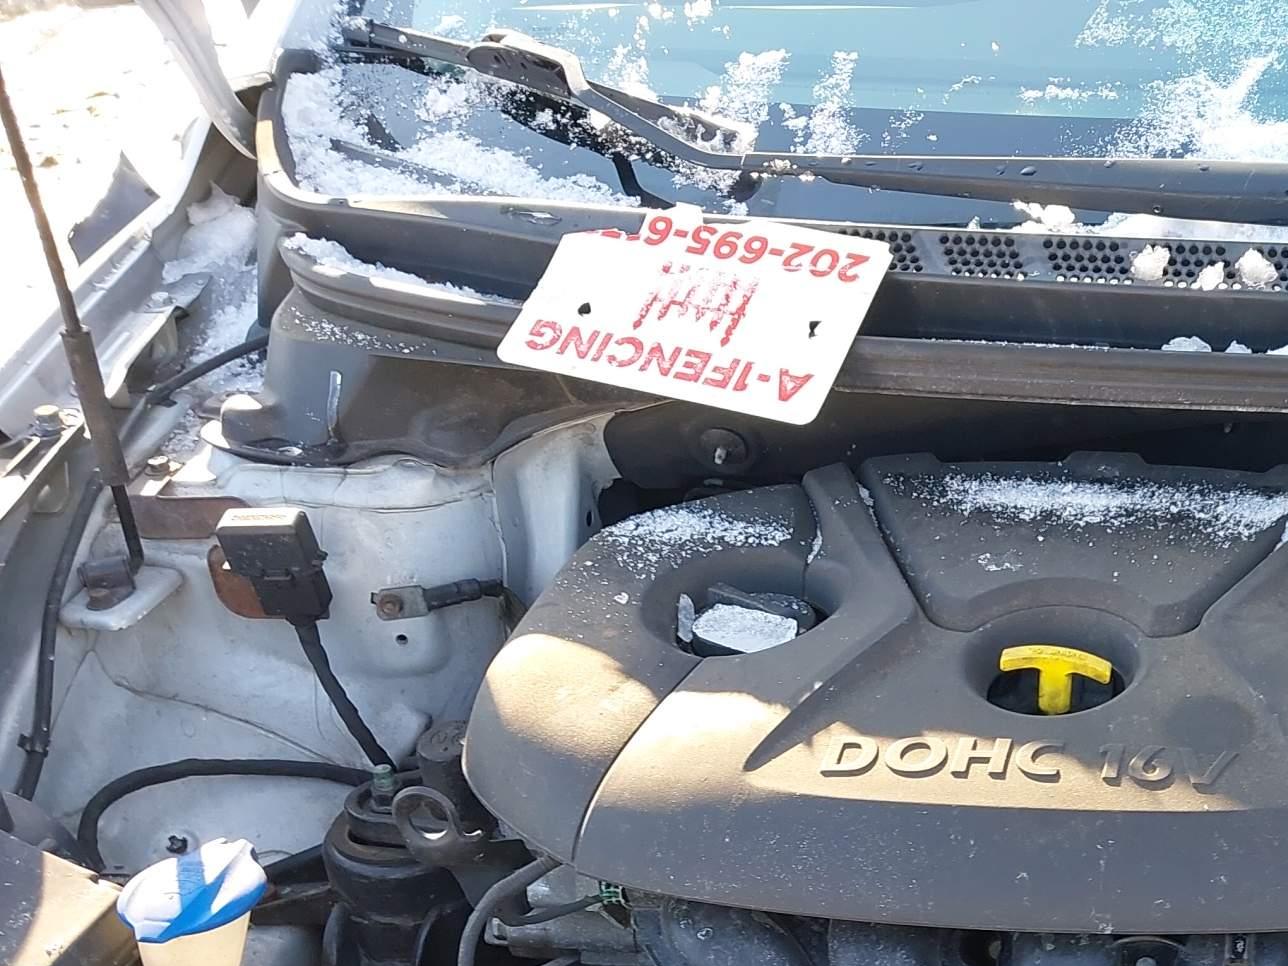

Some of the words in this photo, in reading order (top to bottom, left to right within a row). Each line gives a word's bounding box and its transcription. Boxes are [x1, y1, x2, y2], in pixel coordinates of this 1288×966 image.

[584, 216, 870, 283] 202-695-6
[820, 735, 1066, 784] DOHC
[1100, 742, 1240, 795] 16V
